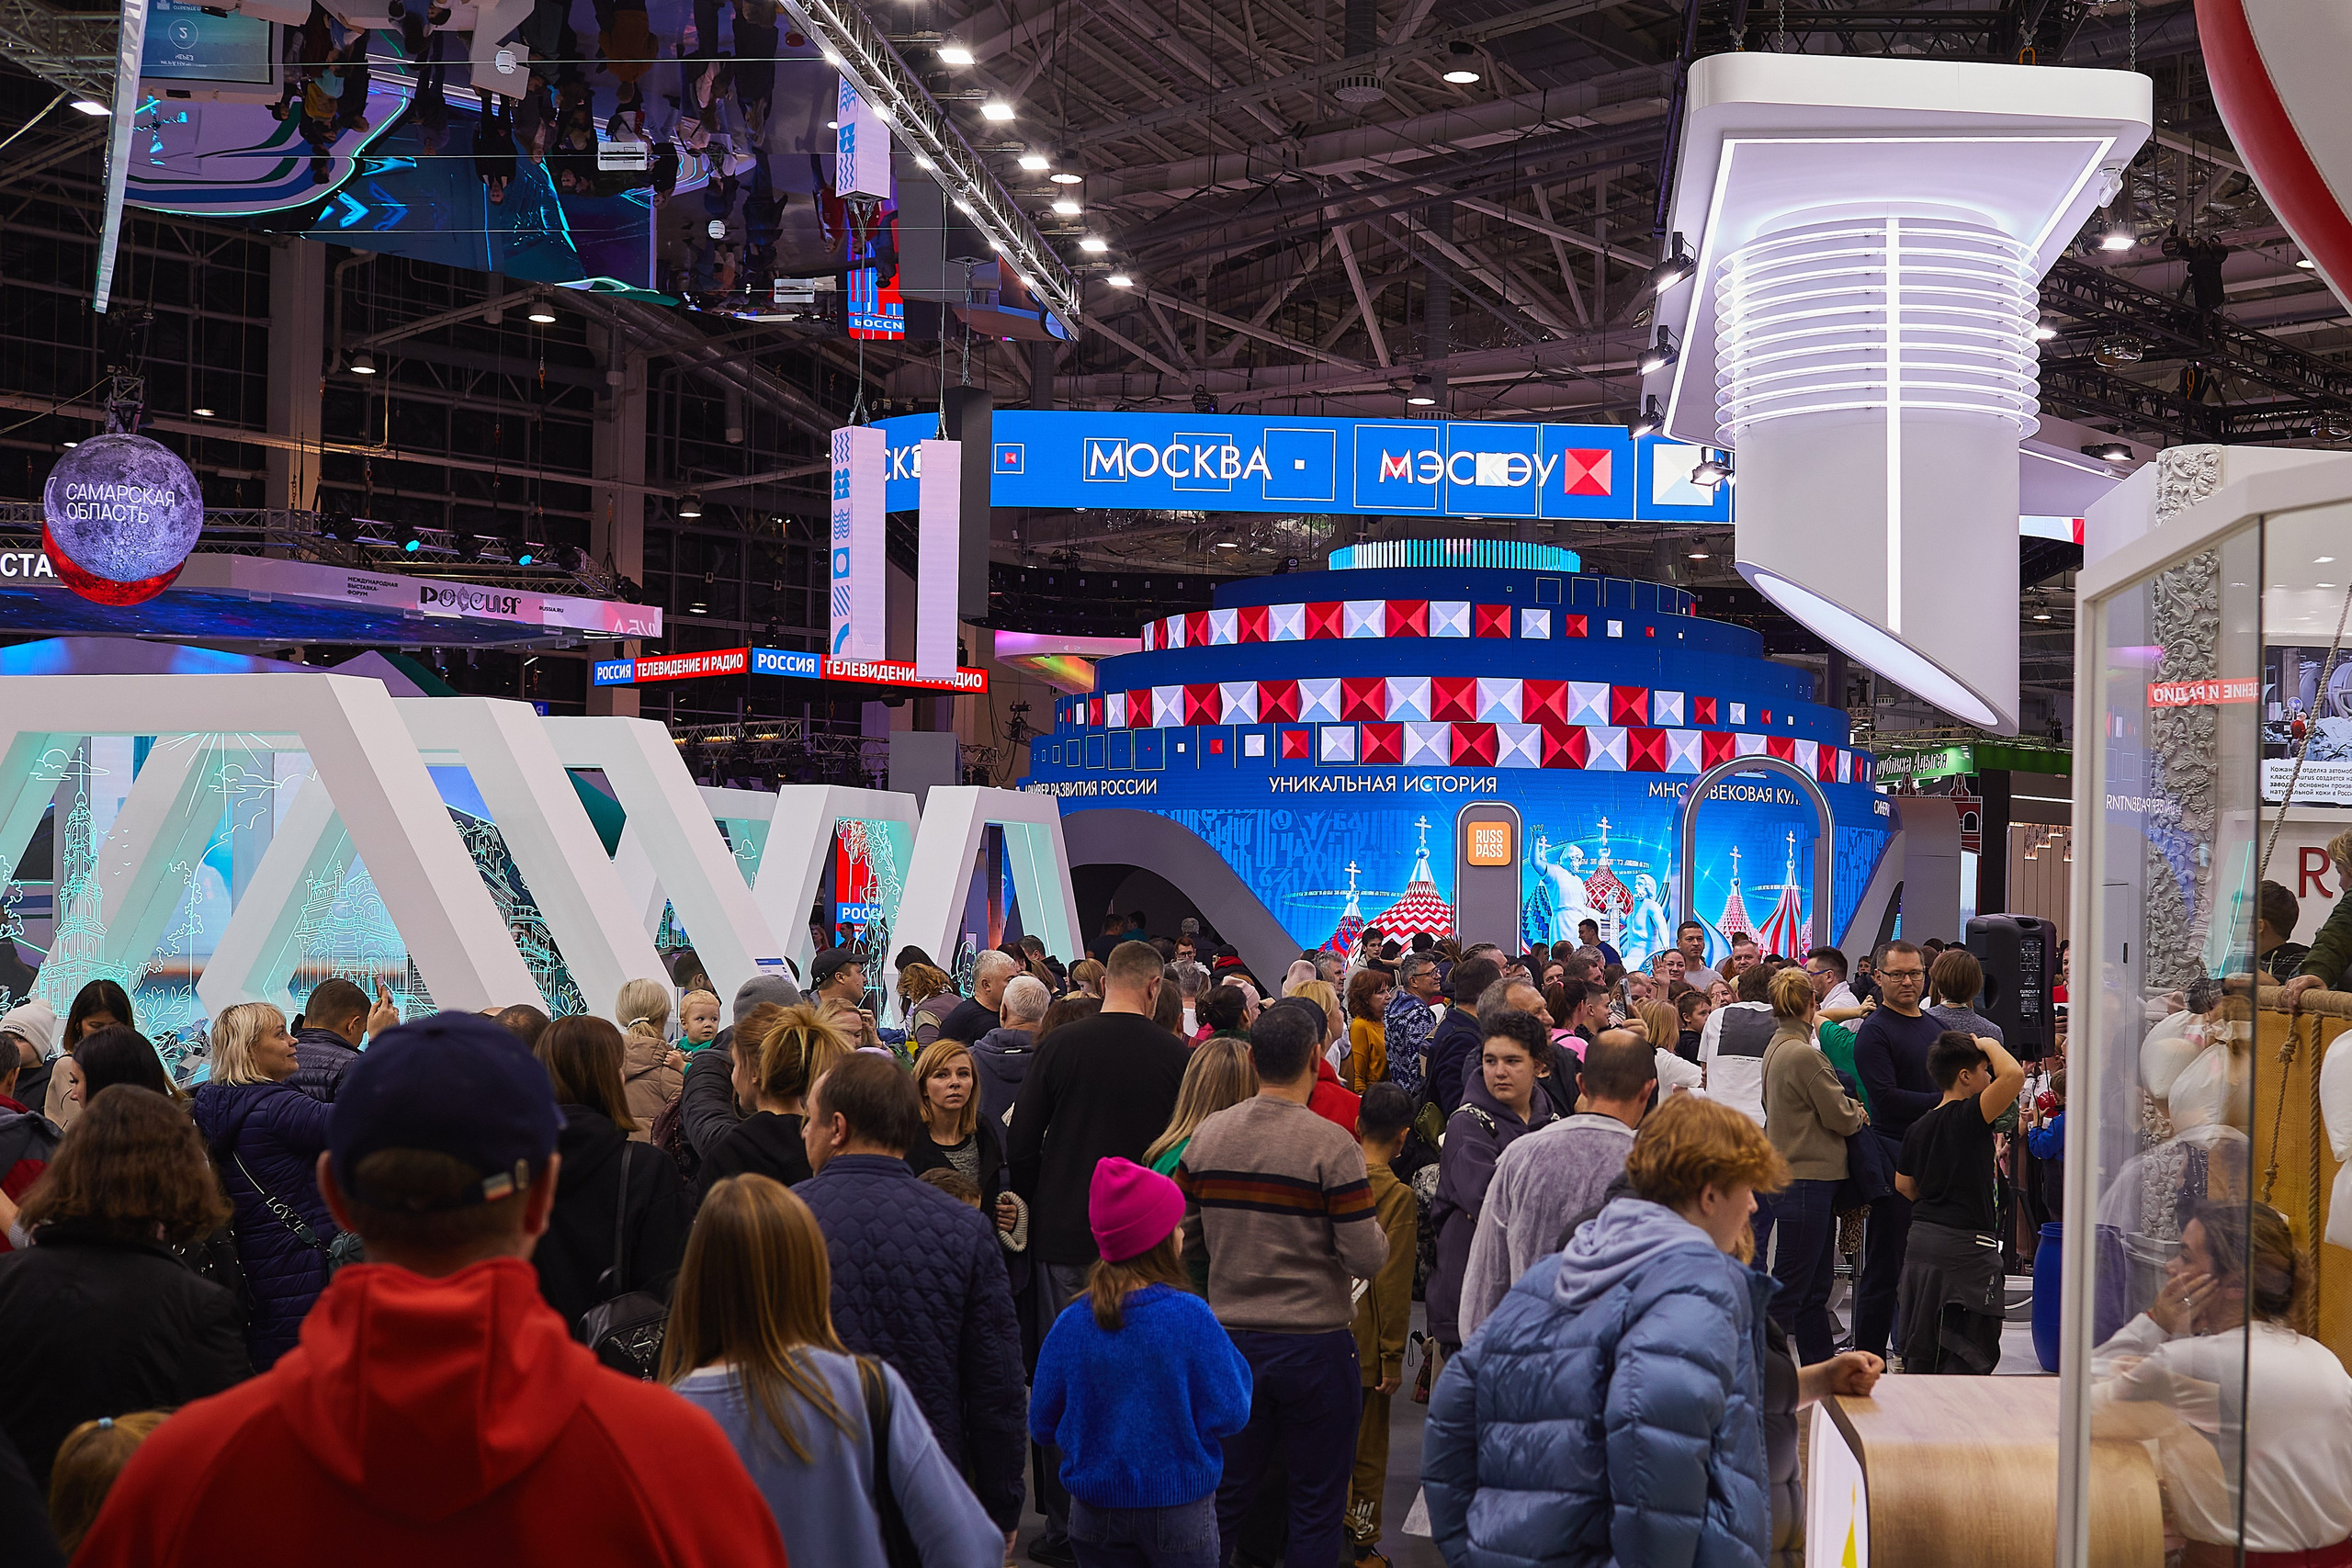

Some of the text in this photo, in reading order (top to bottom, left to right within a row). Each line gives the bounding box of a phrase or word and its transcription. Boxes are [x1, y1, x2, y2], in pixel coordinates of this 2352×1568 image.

[1089, 441, 1273, 480] МОСКВА
[66, 483, 175, 507] САМАРСКАЯ
[66, 502, 149, 524] ОБЛАСТЬ
[0, 553, 58, 577] СТА
[347, 576, 398, 588] МЕЖДУНАРОДНАЯ
[420, 586, 522, 615] РОССИЯ
[538, 605, 564, 614] RUSSIA.RU
[597, 653, 743, 681] РОССИЯ ТЕЛЕВИДЕНИЕ И РАДИО
[758, 653, 982, 688] РОССИЯ ТЕЛЕВИДЕНИ ДИО
[1050, 781, 1098, 797] РАЗВИТИЯ
[1101, 779, 1158, 795] РОССИИ
[1269, 775, 1498, 794] УНИКАЛЬНАЯ ИСТОРИЯ
[1476, 829, 1504, 843] RUSS
[1476, 844, 1504, 858] PASS
[2299, 847, 2334, 898] R
